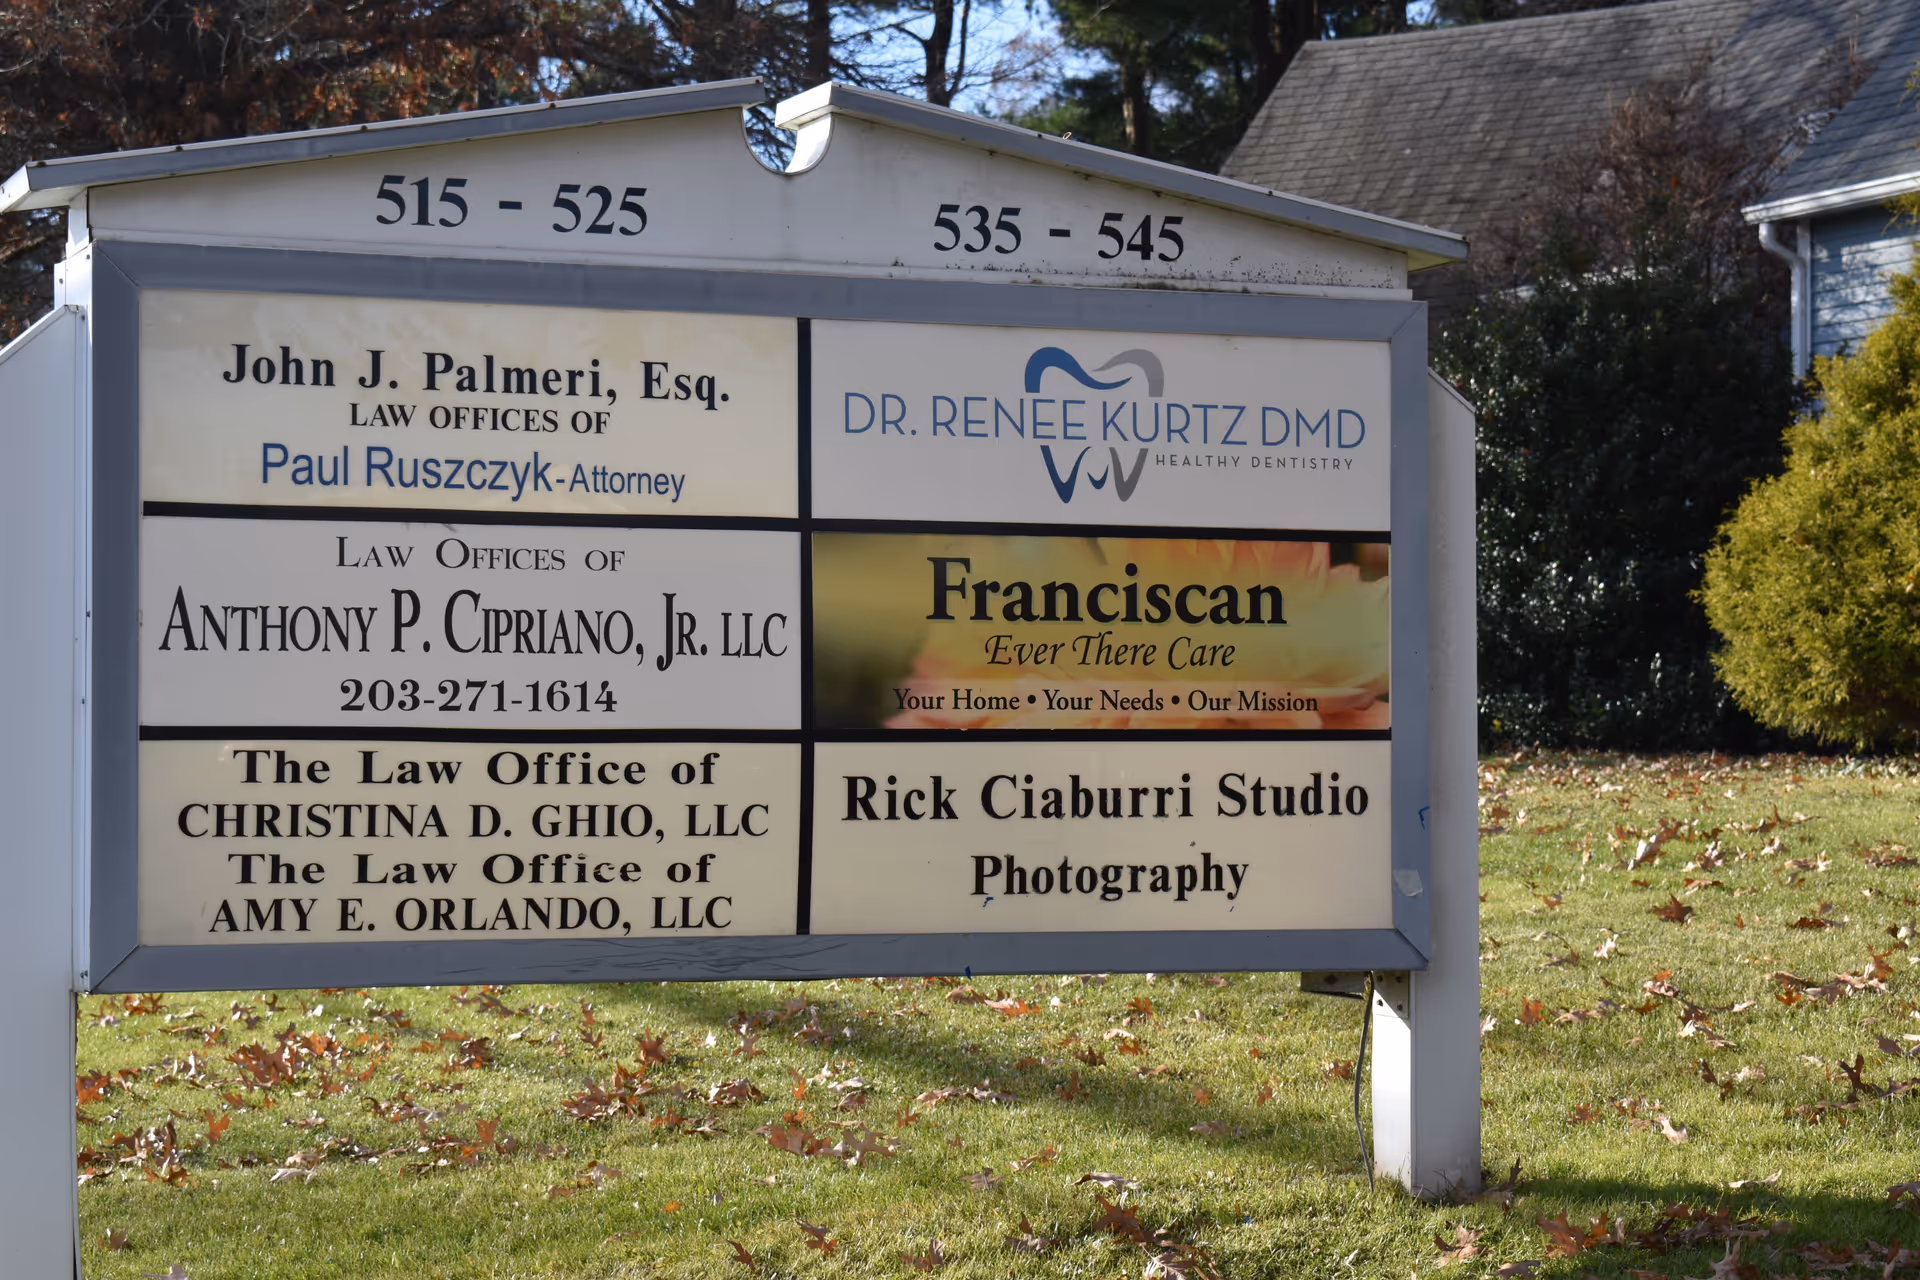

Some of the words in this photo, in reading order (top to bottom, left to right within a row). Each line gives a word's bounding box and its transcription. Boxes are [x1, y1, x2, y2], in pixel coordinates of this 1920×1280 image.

[375, 175, 469, 228] 515
[498, 200, 523, 210] -
[551, 184, 648, 236] 525
[933, 204, 1022, 254] 535
[1048, 228, 1071, 237] -
[1097, 212, 1185, 262] 545
[222, 342, 336, 388] John
[358, 349, 399, 391] J.
[421, 351, 617, 407] Palmeri,
[639, 360, 730, 410] Esq.
[349, 402, 415, 428] LAW
[429, 405, 559, 434] OFFICES
[570, 410, 611, 436] OF
[844, 392, 918, 436] DR.
[931, 395, 1087, 441] RENEE
[1101, 400, 1247, 446] KURTZ
[1260, 406, 1366, 449] DMD
[261, 442, 349, 487] Paul
[1155, 454, 1241, 468] HEALTHY
[1251, 456, 1354, 470] DENTISTRY
[925, 556, 1288, 625] Franciscan
[390, 588, 431, 653] P.
[720, 612, 788, 658] LLC
[984, 634, 1066, 667] Ever
[1071, 631, 1156, 668] There
[1167, 636, 1236, 670] Care
[339, 678, 618, 713] 203-271-1614
[892, 688, 946, 711] Your
[951, 689, 1021, 711] Home
[1043, 689, 1094, 711] Your
[1099, 689, 1164, 711] Needs
[1187, 690, 1231, 712] Our
[1237, 690, 1319, 712] Mission
[232, 749, 331, 785] The
[357, 750, 463, 785] Law
[486, 750, 647, 786] Office
[670, 751, 721, 786] of
[841, 774, 959, 821] Rick
[980, 773, 1194, 820] Ciaburri
[1217, 771, 1369, 818] Studio
[177, 803, 449, 838] CHRISTINA
[468, 803, 513, 838] D.
[531, 803, 665, 843] GHIO,
[683, 803, 770, 838] LLC
[227, 853, 325, 884] The
[351, 853, 458, 884] Law
[482, 853, 642, 884] Office
[665, 853, 717, 884] of
[969, 852, 1249, 902] Photography
[208, 897, 319, 933] AMY
[339, 898, 376, 933] E.
[394, 896, 631, 936] ORLANDO,
[650, 895, 733, 929] LLC
